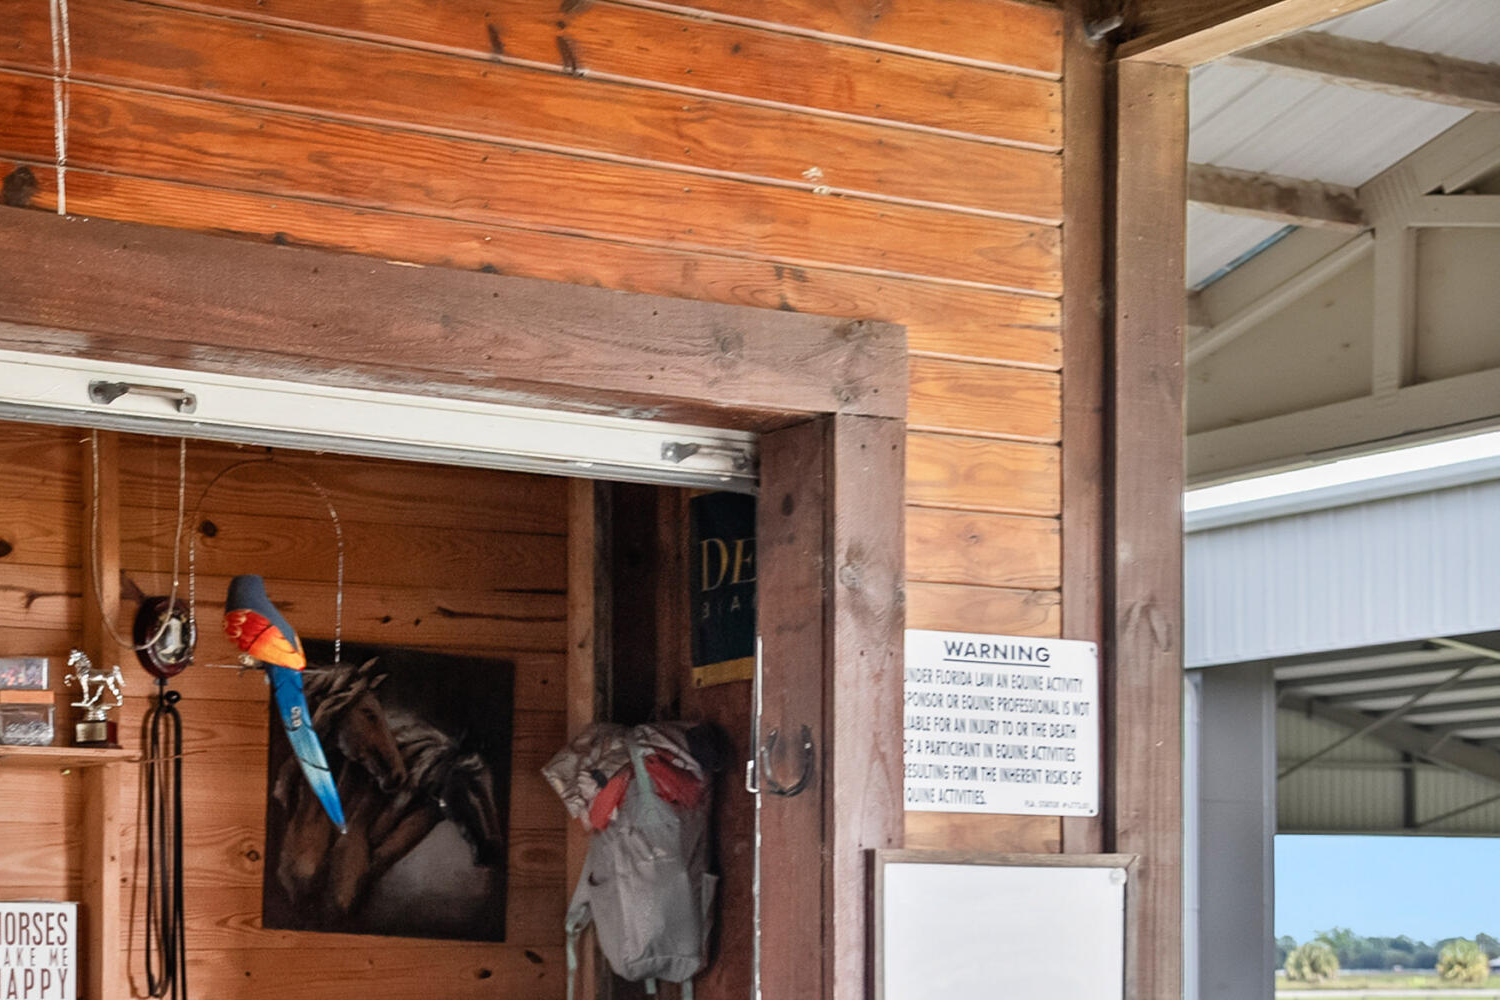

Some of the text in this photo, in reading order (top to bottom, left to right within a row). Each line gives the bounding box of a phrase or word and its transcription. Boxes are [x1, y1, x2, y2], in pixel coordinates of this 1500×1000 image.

[944, 640, 1050, 662] WARNING
[936, 669, 972, 686] FLORIDA
[975, 672, 994, 688] LAW
[997, 673, 1009, 688] AN
[1011, 674, 1043, 690] EQUINE
[1047, 676, 1083, 693] ACTIVITY
[903, 692, 1090, 717] PONSOR OR EQUINE PROFESSIONAL IS NOT
[934, 716, 951, 732] FOR
[954, 717, 967, 733] AN
[969, 718, 999, 735] INJURY
[1001, 720, 1013, 736] TO
[1016, 721, 1028, 737] OR
[1031, 722, 1047, 738] THE
[1050, 723, 1077, 739] DEATH
[916, 739, 922, 754] A
[925, 740, 980, 758] PARTICIPANT
[983, 743, 994, 758] IN
[996, 743, 1028, 760] EQUINE
[1031, 745, 1076, 762] ACTIVITIES
[903, 763, 1082, 785] ESULTING FROM THE INHERENT RISKS OF
[903, 787, 935, 803] QUINE
[48, 947, 68, 967] ME
